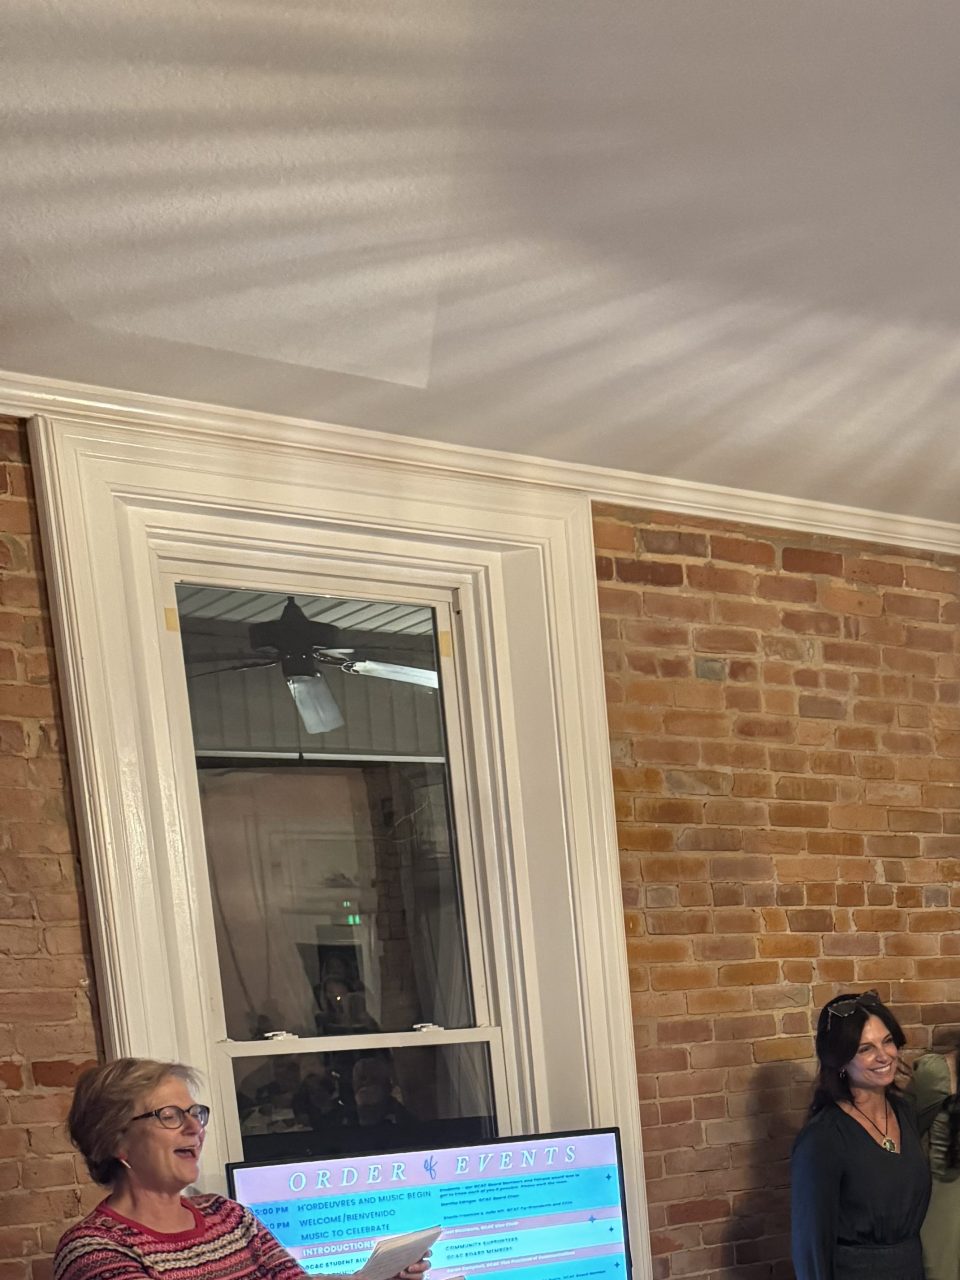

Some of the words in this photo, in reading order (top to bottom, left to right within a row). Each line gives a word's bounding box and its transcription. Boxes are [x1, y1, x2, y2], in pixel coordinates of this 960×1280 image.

[289, 1162, 407, 1192] ORDER
[424, 1155, 438, 1180] of
[455, 1145, 576, 1175] EVENTS
[358, 1196, 376, 1205] AND
[378, 1193, 404, 1202] MUSIC
[407, 1191, 431, 1200] BEGIN
[299, 1209, 396, 1227] WELCOME/BIENVENIDO
[301, 1230, 330, 1241] MUSIC
[332, 1229, 344, 1237] TO
[345, 1224, 390, 1236] CELEBRATE
[325, 1258, 354, 1268] STUDENT
